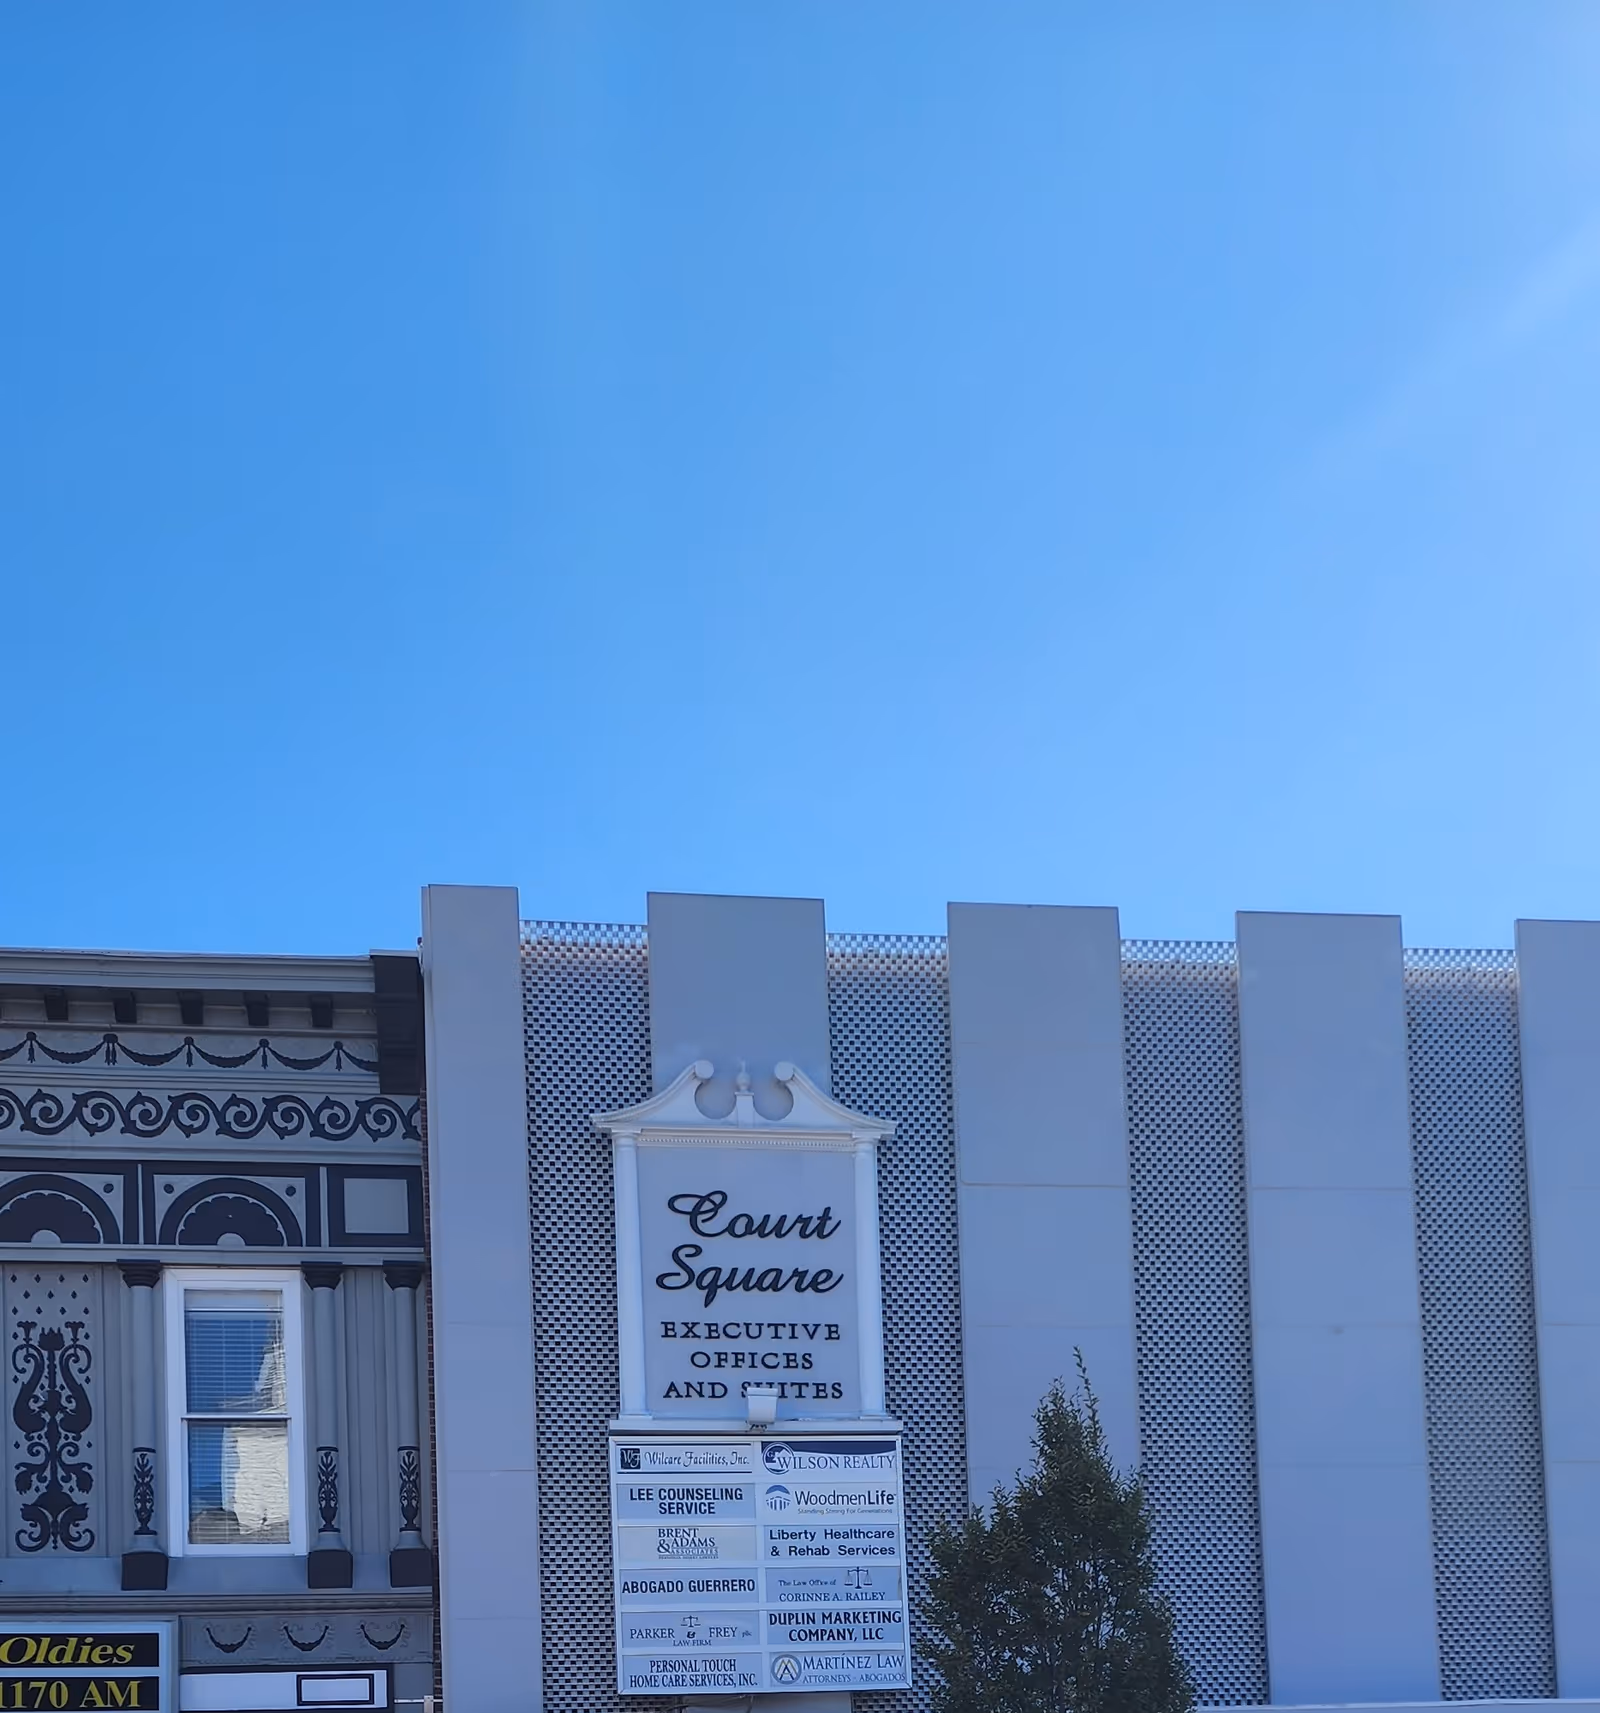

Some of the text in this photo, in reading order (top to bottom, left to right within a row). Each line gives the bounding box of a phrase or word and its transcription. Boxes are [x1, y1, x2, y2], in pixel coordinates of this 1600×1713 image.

[667, 1190, 842, 1239] Court
[656, 1244, 844, 1308] Square
[661, 1321, 841, 1340] EXECUTIVE
[690, 1351, 813, 1370] OFFICES
[663, 1381, 728, 1399] AND
[644, 1451, 682, 1466] Wilcare
[683, 1451, 728, 1467] Facilities,
[730, 1451, 750, 1465] Inc.
[777, 1454, 896, 1470] WILSON REALTY
[630, 1487, 743, 1501] LEE COUNSELING
[795, 1489, 895, 1506] WoodmenLife
[658, 1502, 716, 1515] SERVICE
[657, 1528, 699, 1538] BRENT
[769, 1529, 895, 1542] Liberty Healthcare
[657, 1537, 716, 1554] & ADAMS
[771, 1544, 896, 1557] & Rehab Services
[622, 1579, 756, 1594] ABOGADO GUERRERO
[779, 1592, 831, 1602] CORINNE
[845, 1592, 886, 1602] RAILEY
[769, 1610, 902, 1626] DUPLIN MARKETING
[630, 1628, 675, 1640] PARKER
[708, 1626, 738, 1639] FREY
[788, 1628, 884, 1642] COMPANY, LLC
[0, 1636, 135, 1664] Oldies
[650, 1658, 737, 1673] PERSONAL TOUCH
[630, 1673, 758, 1688] HOME CARE SERVICES, INC.
[79, 1680, 143, 1708] AM
